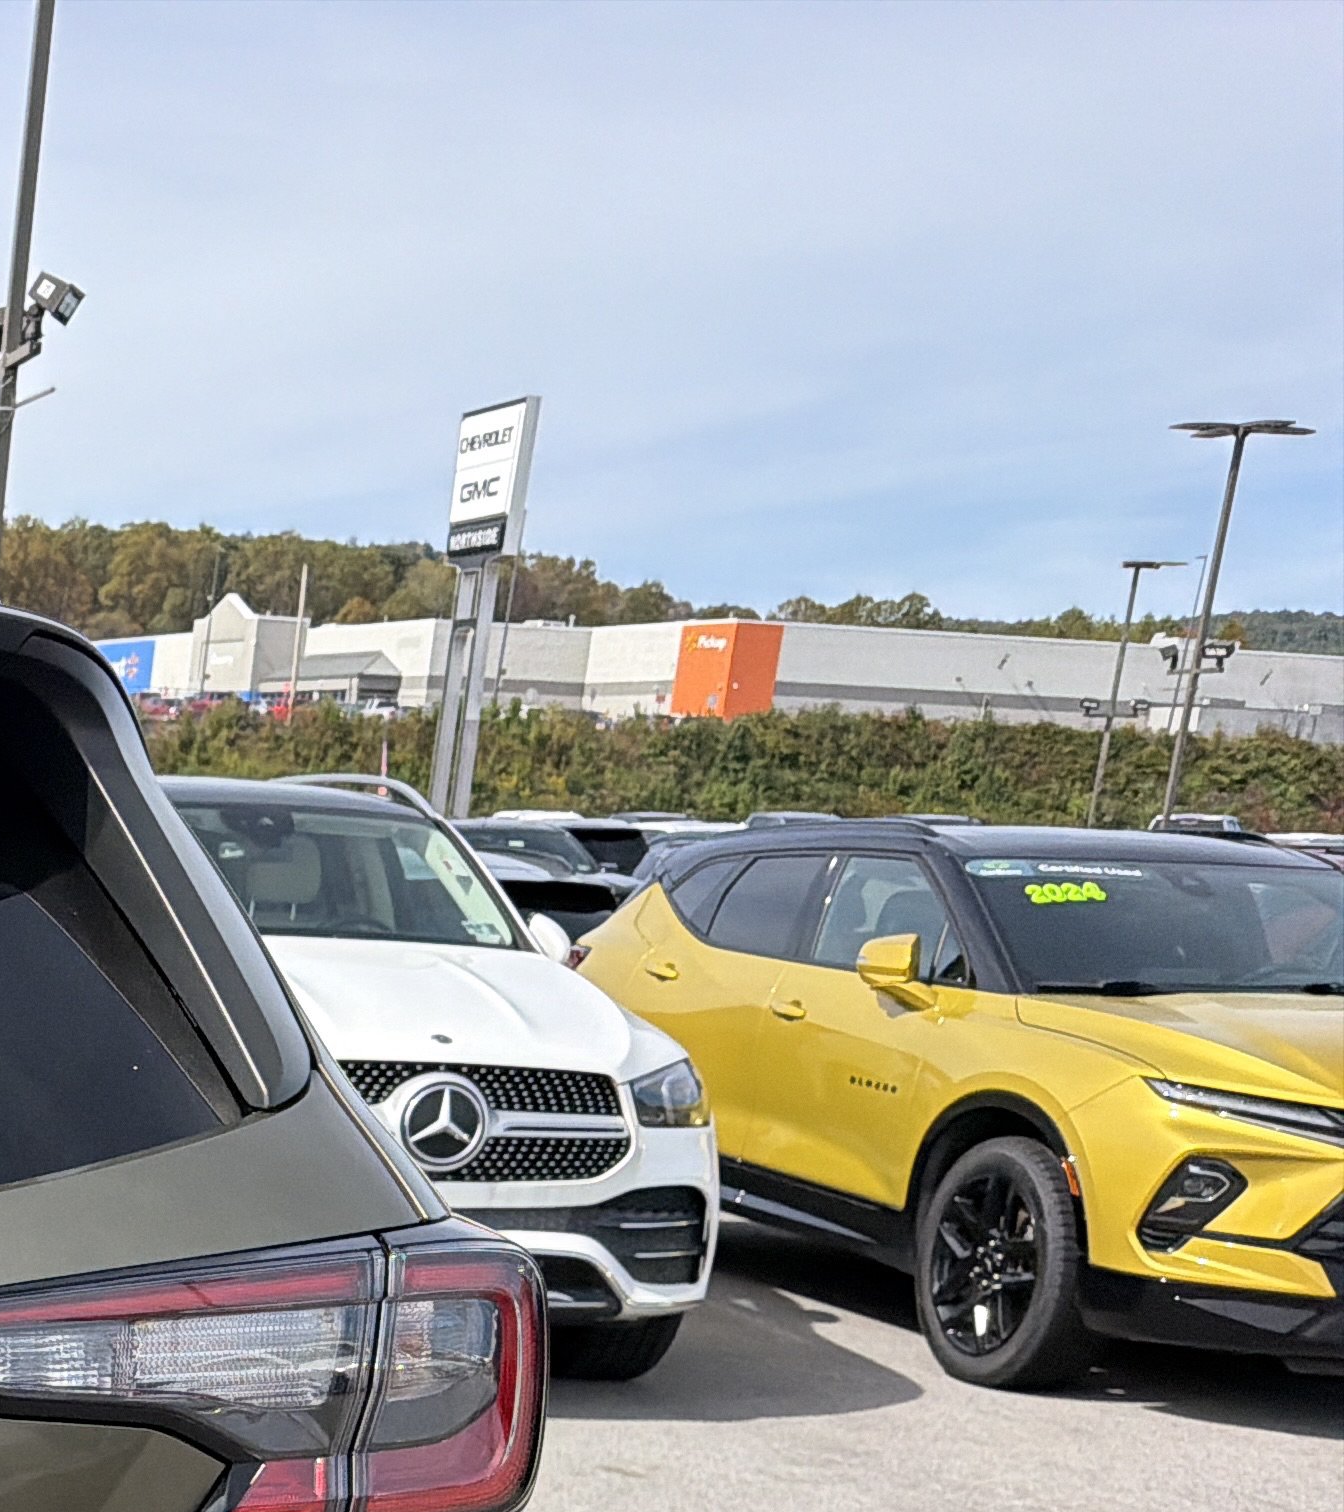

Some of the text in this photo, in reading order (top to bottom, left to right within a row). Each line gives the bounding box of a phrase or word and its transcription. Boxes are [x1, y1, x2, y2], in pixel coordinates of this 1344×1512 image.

[459, 426, 515, 454] CHEVROLET
[459, 476, 501, 503] GMC
[1024, 881, 1108, 904] 2024
